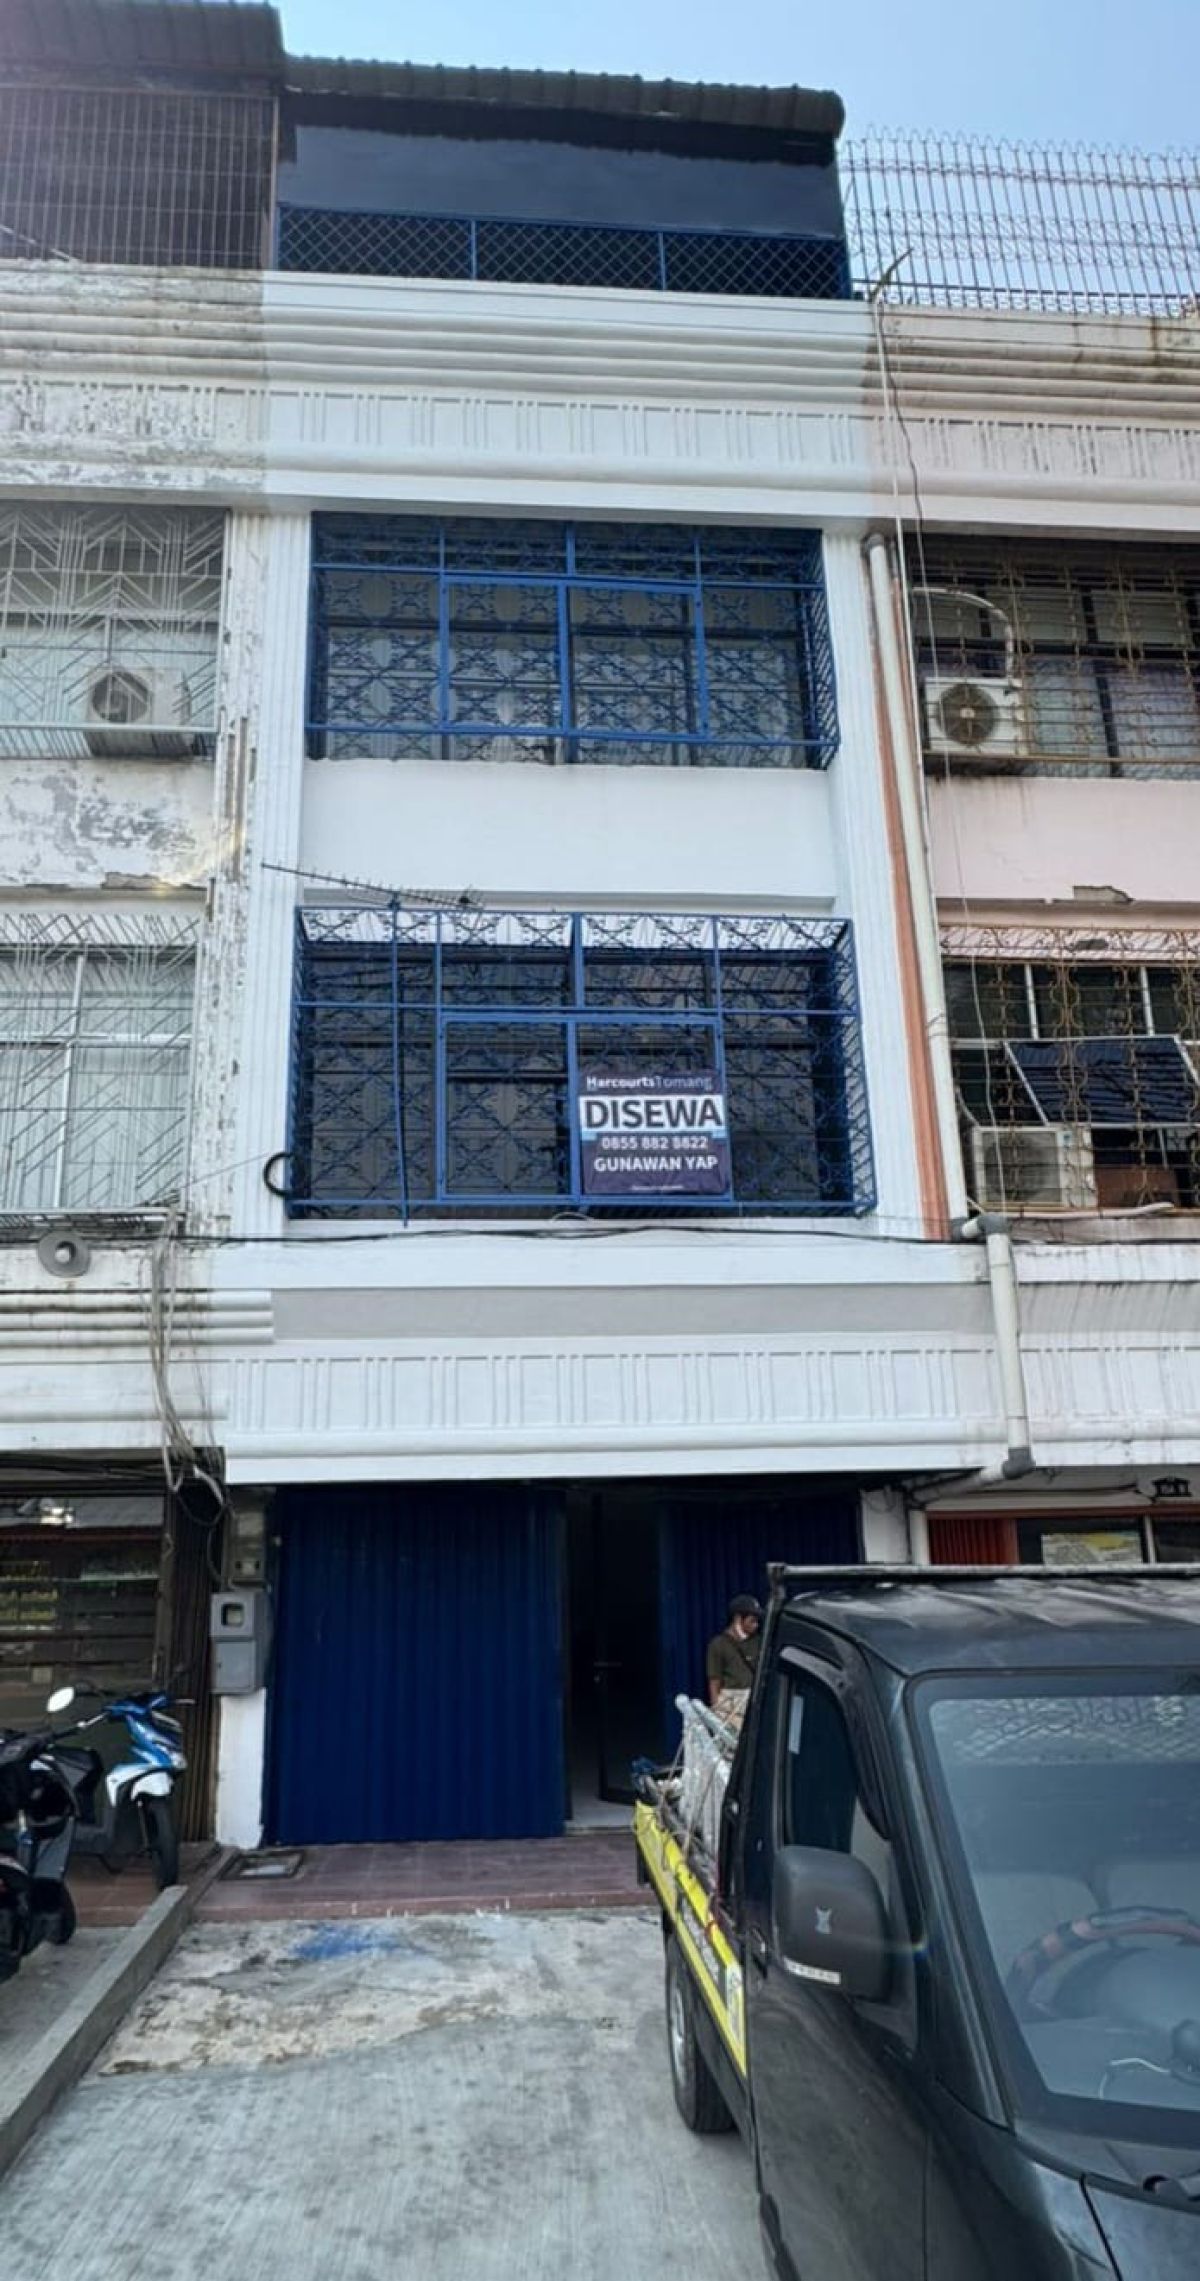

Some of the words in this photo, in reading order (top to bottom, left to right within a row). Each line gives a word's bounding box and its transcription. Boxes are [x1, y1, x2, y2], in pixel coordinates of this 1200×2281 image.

[584, 1099, 723, 1129] DISEWA
[601, 1135, 638, 1150] 0855
[641, 1135, 669, 1150] 882
[594, 1156, 681, 1172] GUNAWAN
[685, 1155, 719, 1170] YAP
